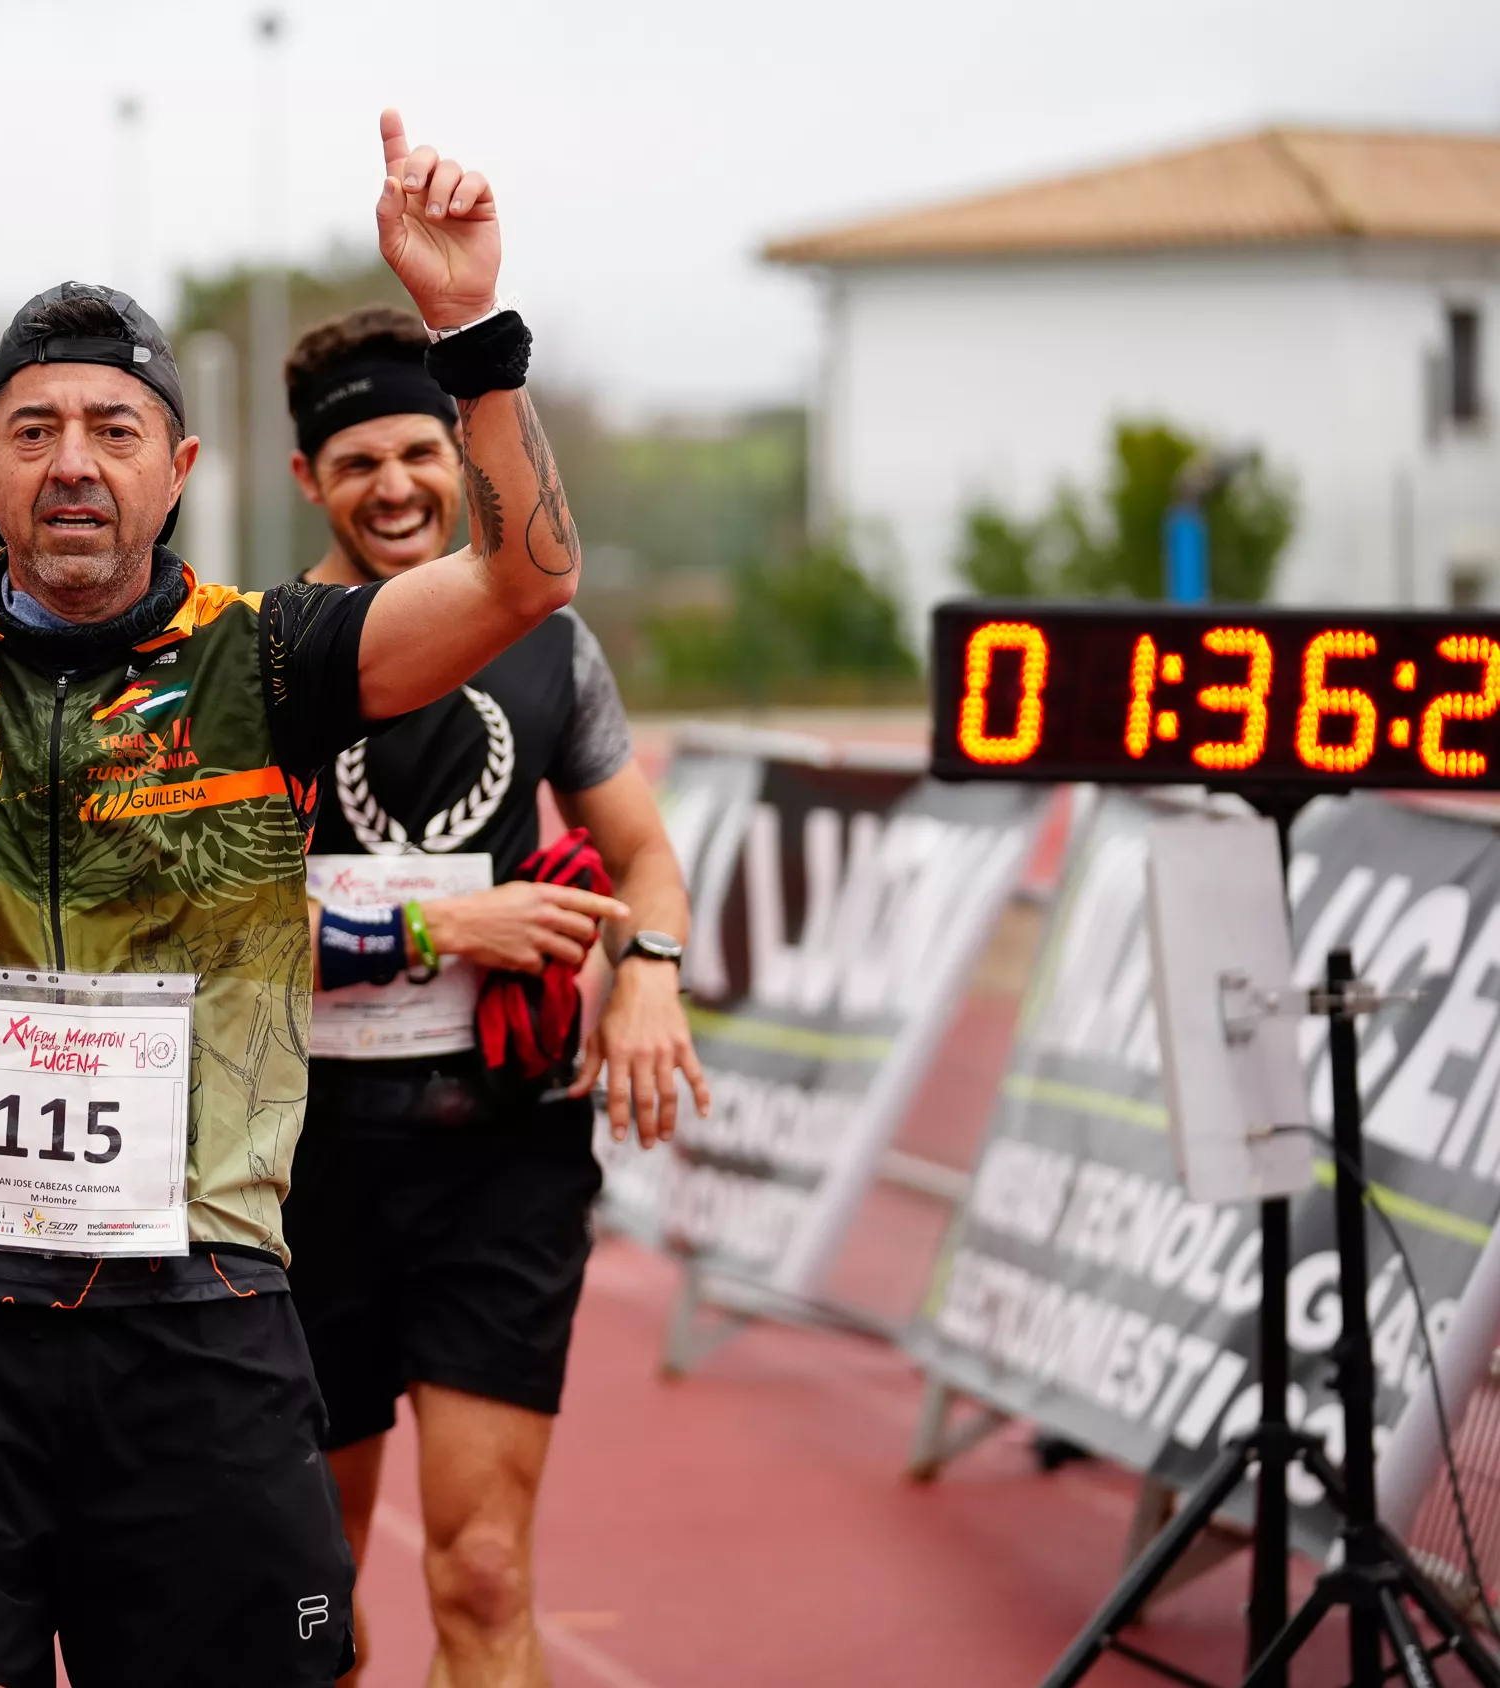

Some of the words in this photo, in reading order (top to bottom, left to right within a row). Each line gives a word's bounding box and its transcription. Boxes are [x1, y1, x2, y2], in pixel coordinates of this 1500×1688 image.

[98, 734, 146, 749] TRAIL
[130, 786, 207, 810] GUILLENA
[64, 1028, 126, 1048] MARATÓN
[30, 1044, 112, 1076] LUCENA
[13, 1178, 33, 1189] JOSE
[34, 1181, 73, 1192] CABEZAS
[75, 1183, 121, 1194] CARMONA
[30, 1193, 77, 1206] M-Hombre
[87, 1222, 171, 1231] mediamaratonlucena.com
